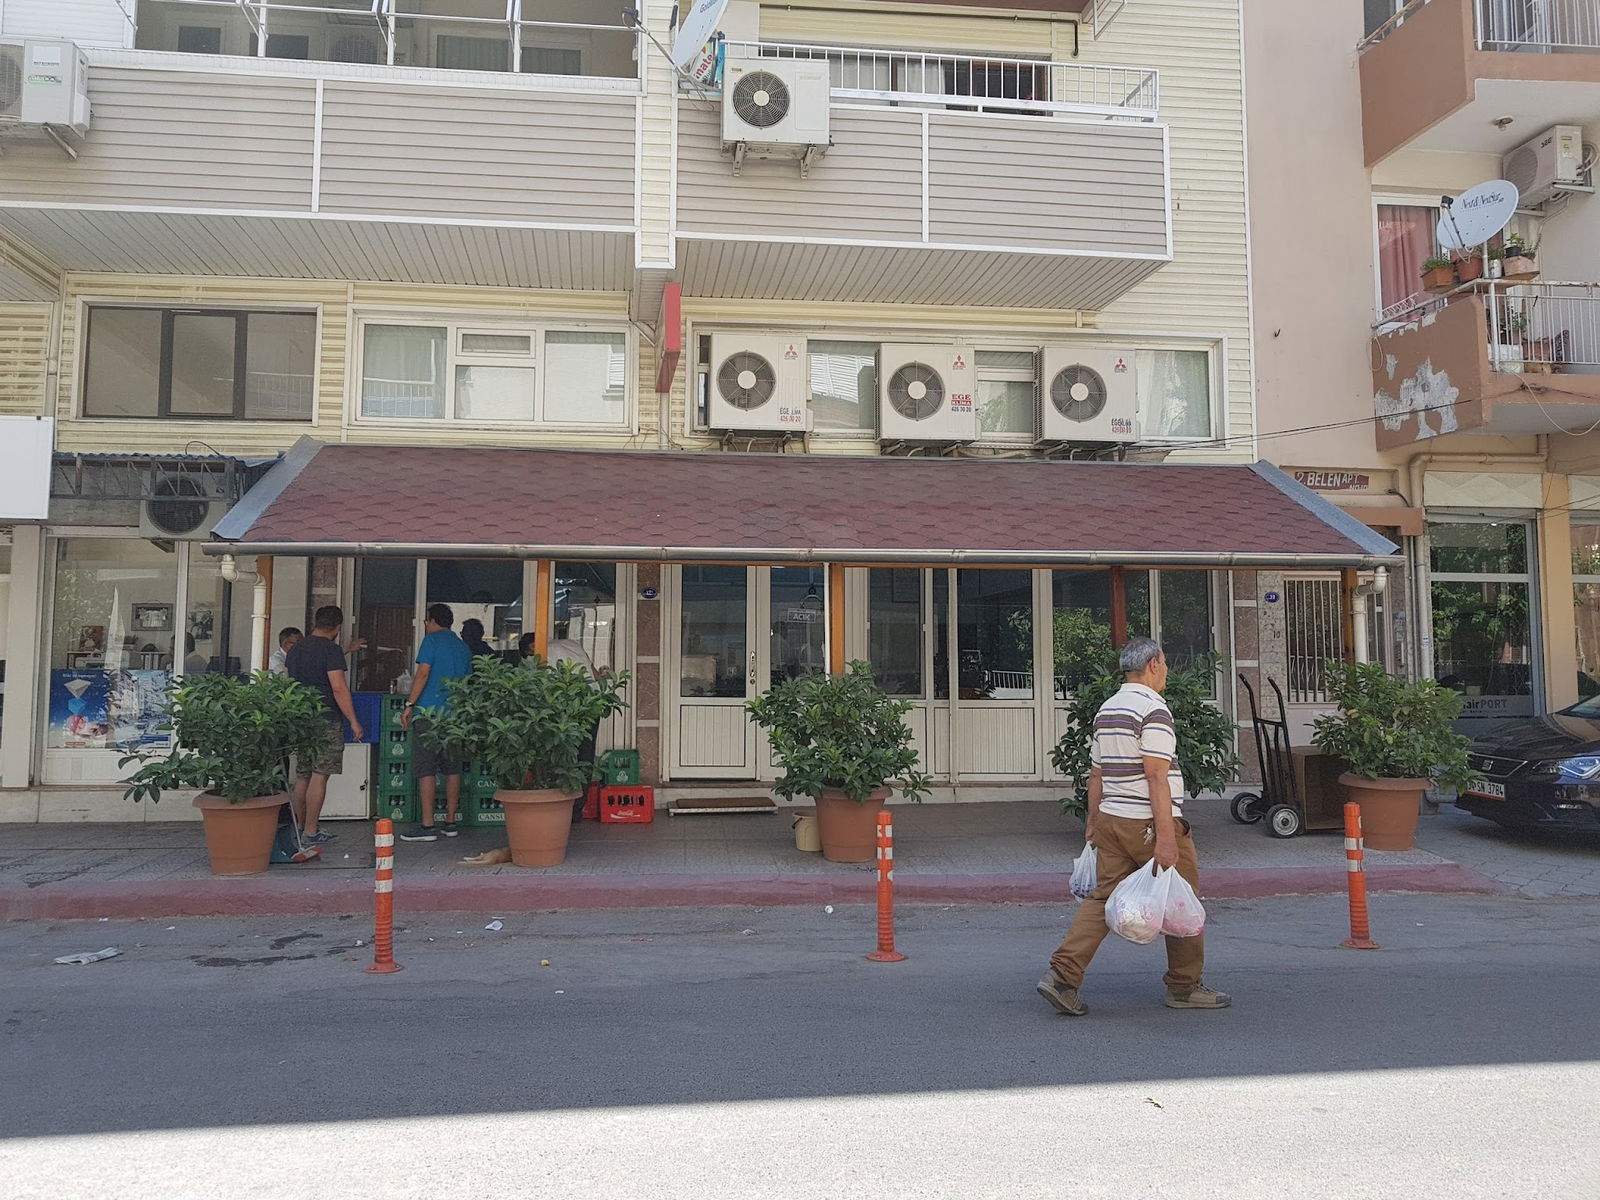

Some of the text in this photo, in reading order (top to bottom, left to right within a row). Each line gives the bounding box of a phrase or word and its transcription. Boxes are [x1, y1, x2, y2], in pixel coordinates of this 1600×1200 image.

[1307, 472, 1341, 487] BELEN
[1476, 781, 1485, 793] SN
[1487, 783, 1504, 797] 3784
